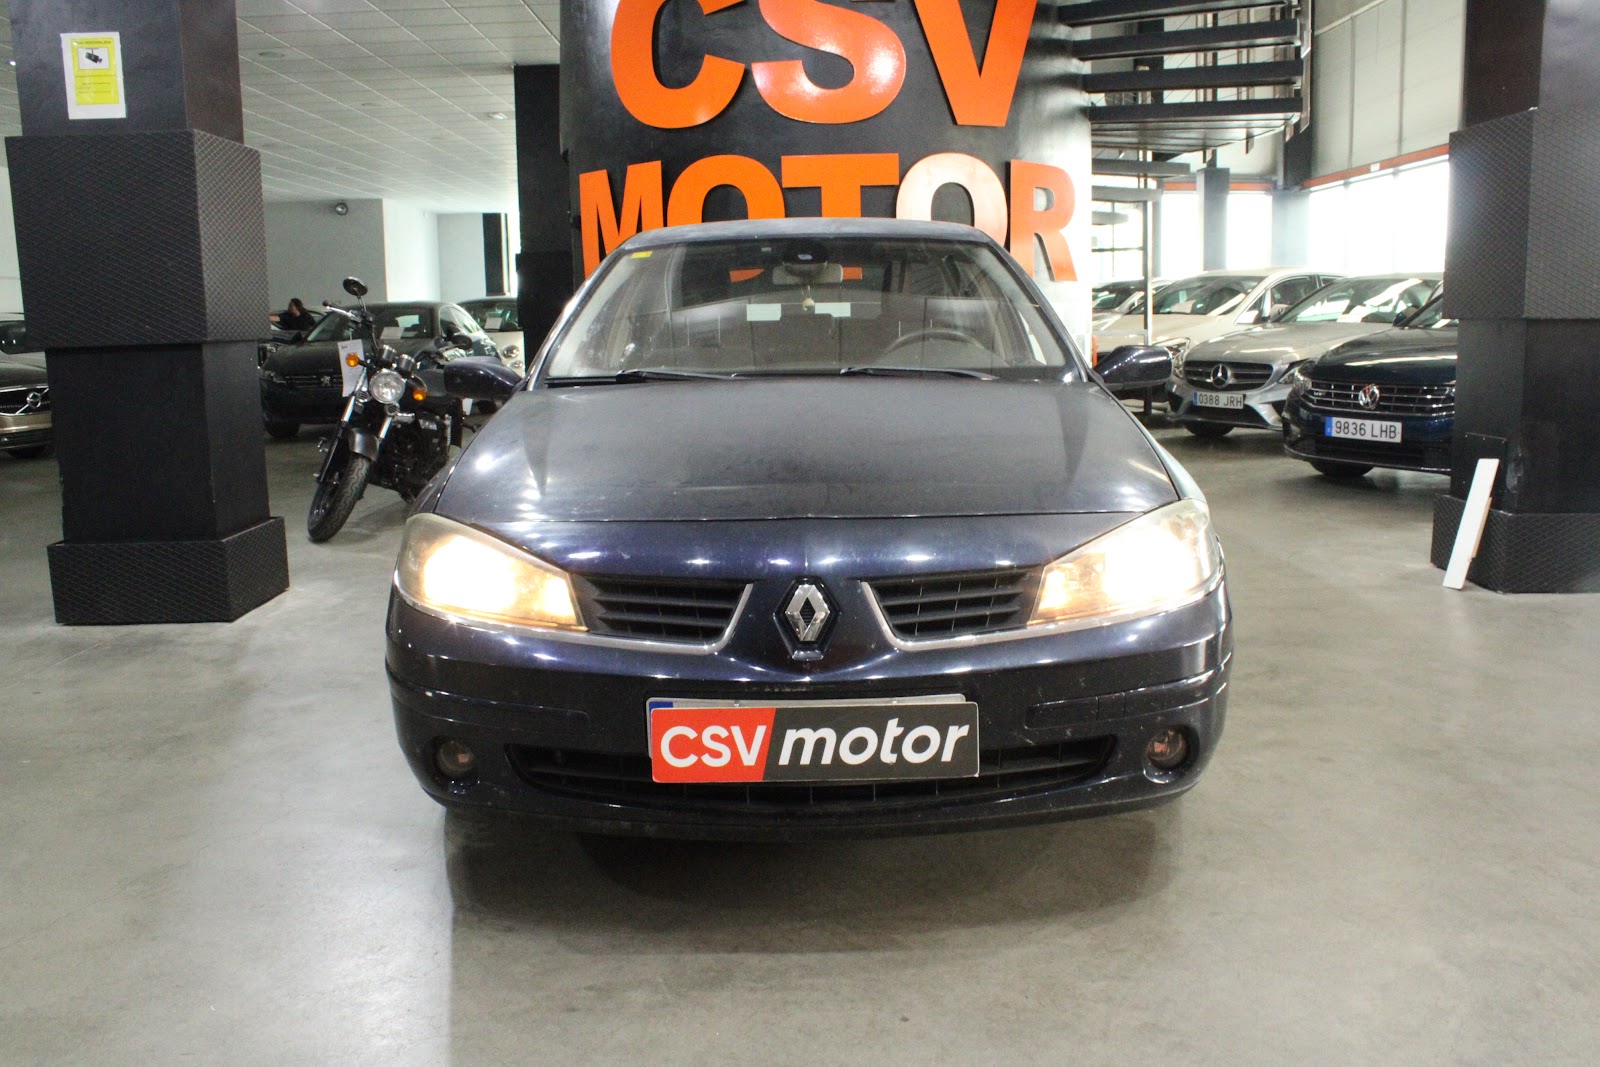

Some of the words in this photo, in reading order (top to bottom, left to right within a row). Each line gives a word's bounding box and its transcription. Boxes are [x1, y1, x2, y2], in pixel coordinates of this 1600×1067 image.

[610, 0, 1037, 128] CSV
[1198, 393, 1220, 406] 0388
[1223, 396, 1242, 407] JRH
[1335, 420, 1366, 436] 9836
[1371, 423, 1397, 439] LHB
[660, 725, 767, 768] CSV
[778, 717, 970, 766] motor
